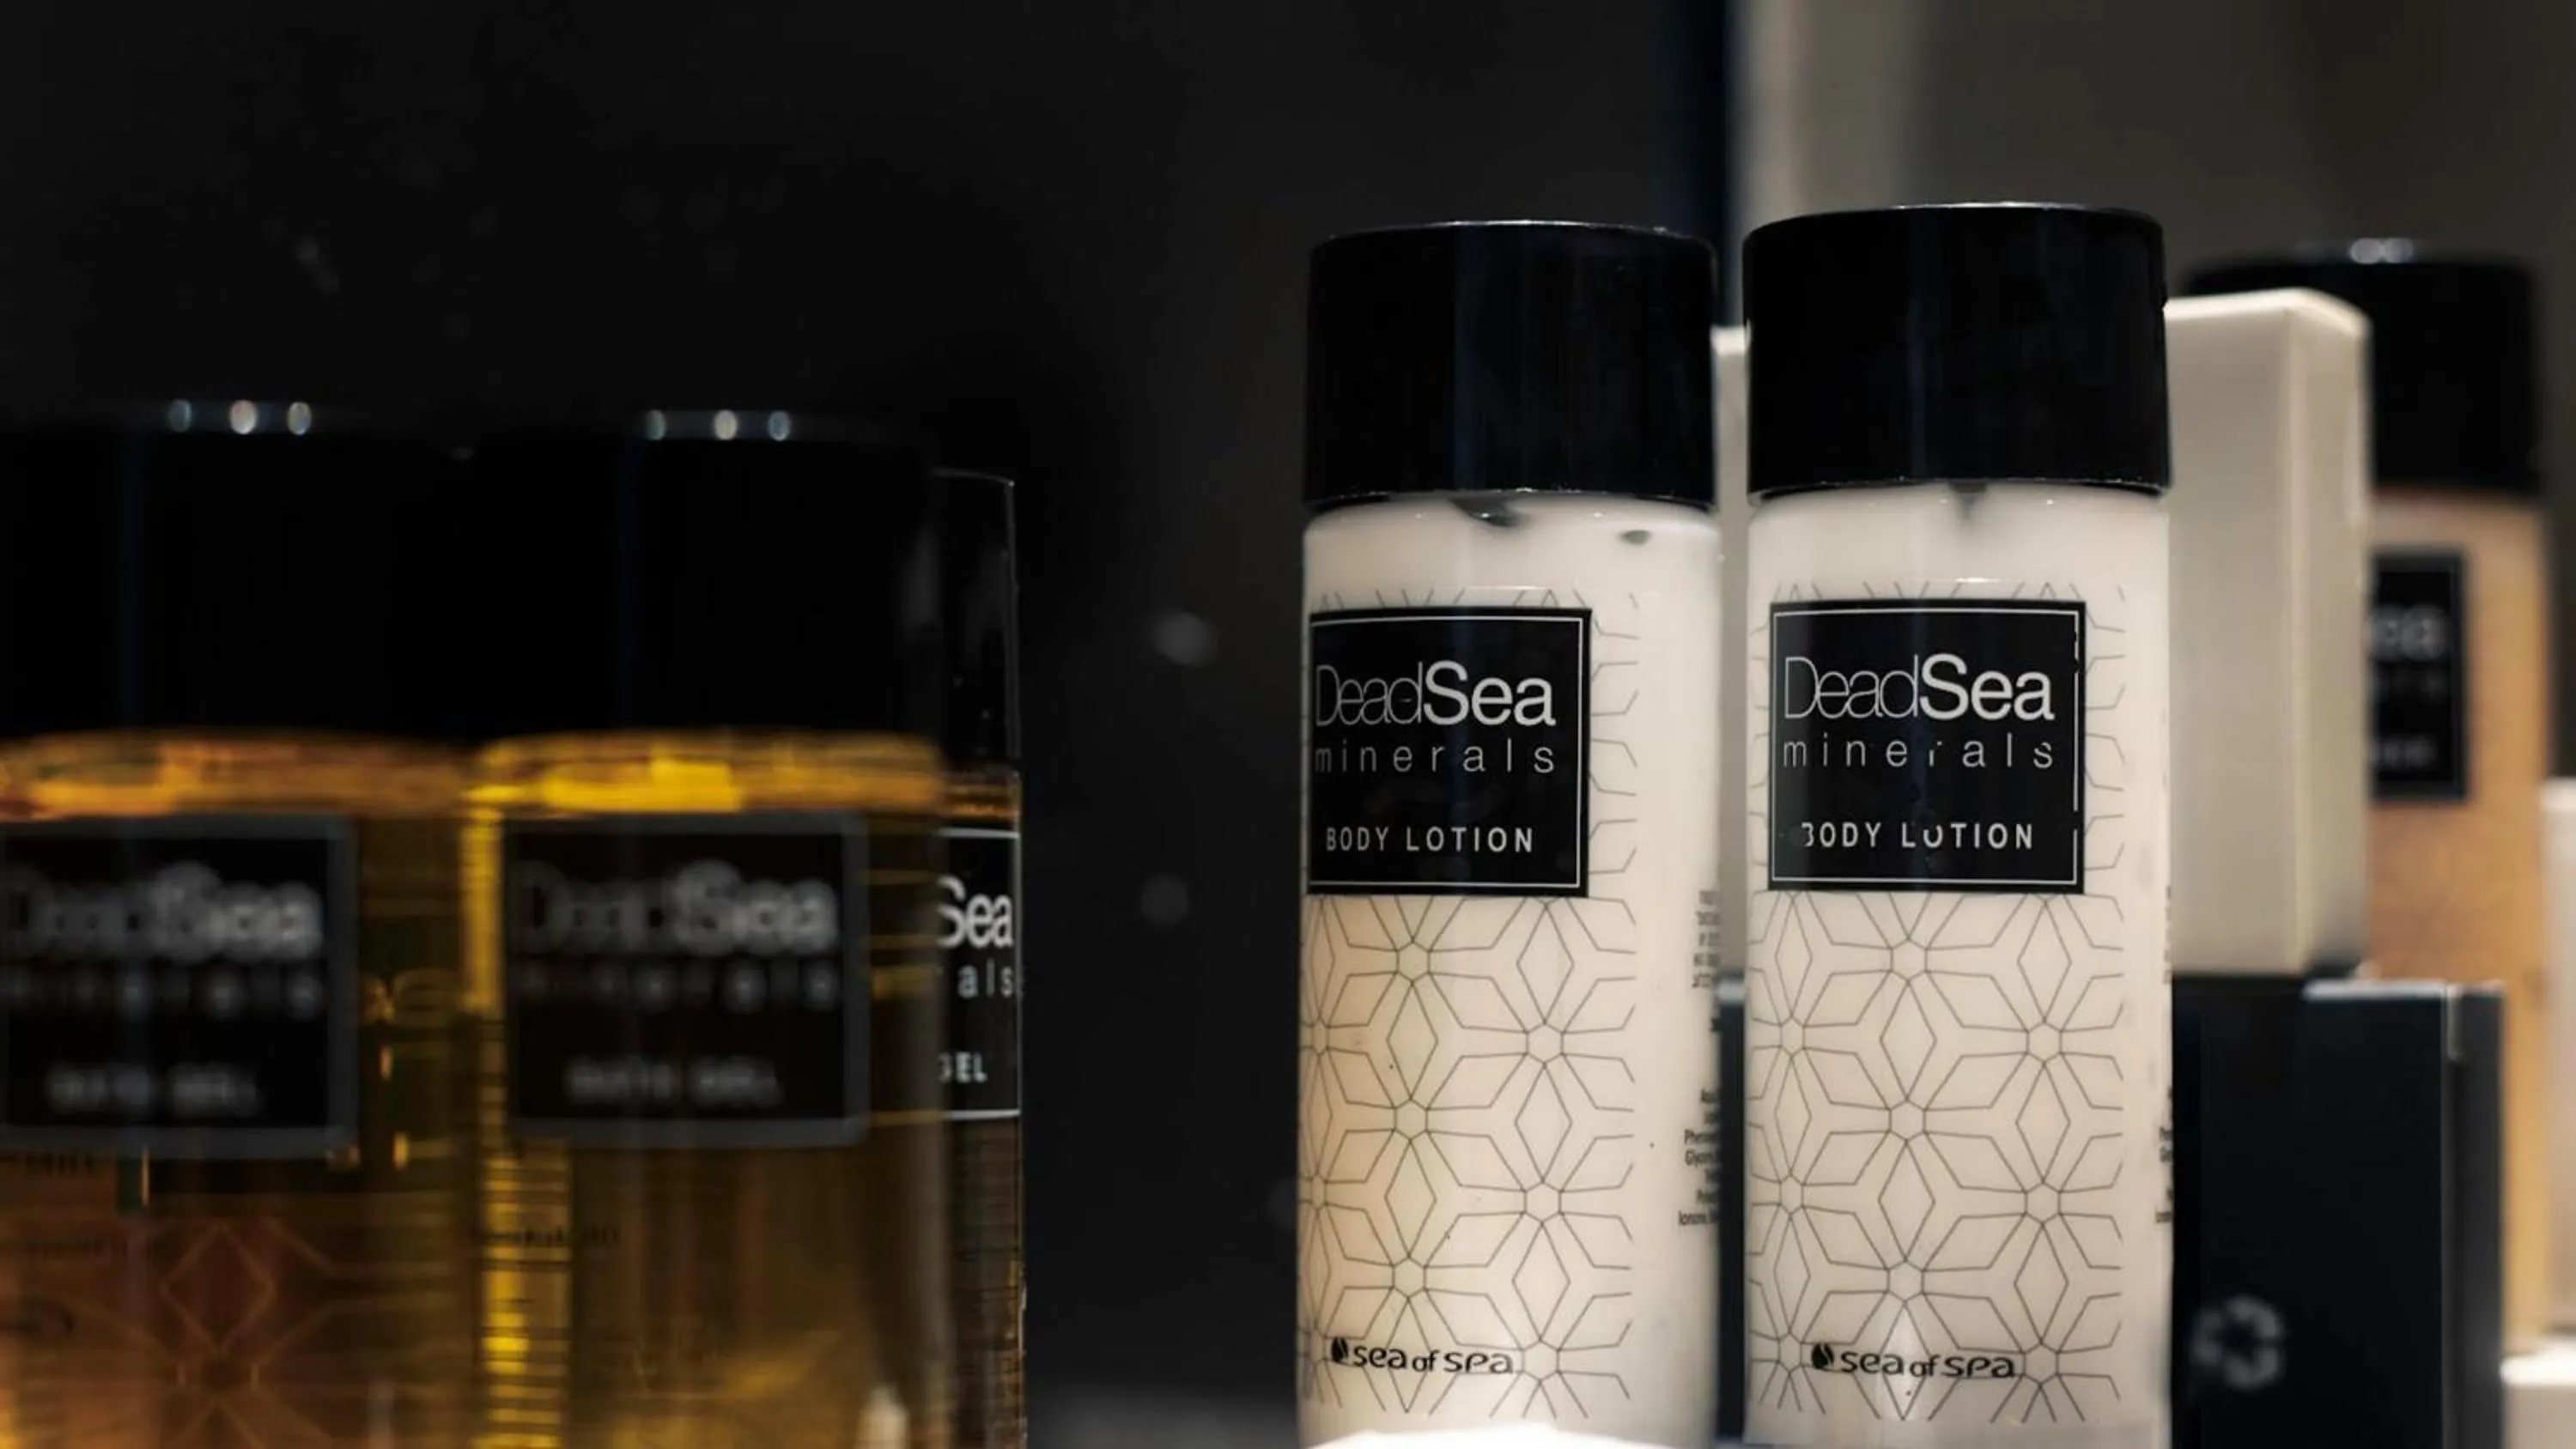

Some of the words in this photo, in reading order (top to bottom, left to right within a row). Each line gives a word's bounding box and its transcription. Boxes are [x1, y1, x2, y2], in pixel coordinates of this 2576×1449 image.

[1315, 737, 1555, 773] minerals
[1783, 732, 2053, 769] minerals
[1326, 828, 1389, 852] BODY
[1405, 827, 1534, 852] LOTION
[1901, 822, 2033, 850] LOTION
[1352, 1345, 1406, 1370] sea
[1412, 1349, 1441, 1373] of
[1443, 1352, 1514, 1374] spa
[1840, 1350, 1904, 1375] sea
[1909, 1355, 1941, 1377] of
[1943, 1356, 2015, 1379] spa
